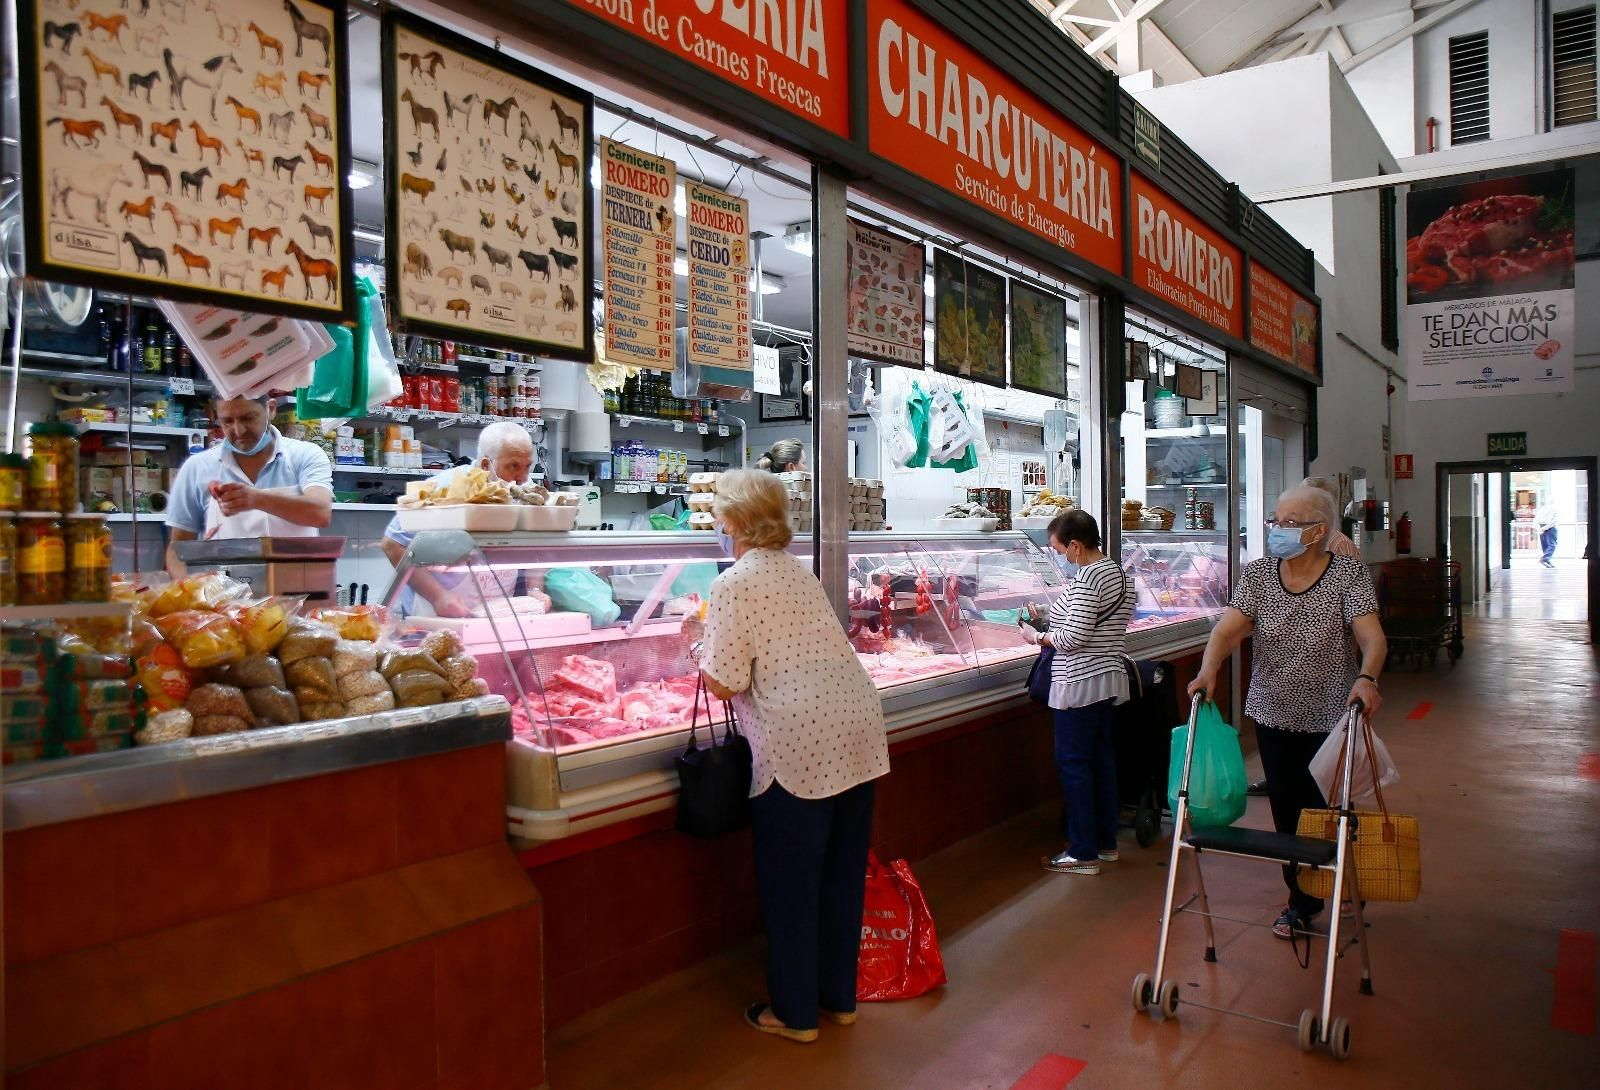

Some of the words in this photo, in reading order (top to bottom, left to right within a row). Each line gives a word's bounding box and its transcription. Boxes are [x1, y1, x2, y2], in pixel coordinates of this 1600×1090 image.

[643, 0, 669, 41] de
[677, 15, 749, 81] Carnes
[755, 54, 822, 118] Frescas
[878, 18, 1114, 240] CHARCUTERÍA
[607, 143, 666, 175] Carnicería
[606, 160, 670, 198] ROMERO
[605, 184, 643, 207] DESPIECE
[645, 197, 654, 210] de
[955, 163, 1007, 213] Servicio
[1011, 193, 1024, 222] de
[1028, 202, 1075, 249] Encargos
[605, 198, 653, 232] TERNERA
[690, 202, 744, 236] ROMERO
[690, 225, 721, 244] DESPIECE
[690, 239, 730, 266] CERDO
[1137, 193, 1234, 311] ROMERO
[1147, 268, 1188, 306] Elaboración
[1188, 291, 1208, 319] Propia
[1444, 302, 1486, 312] MERCADOS
[1422, 314, 1444, 332] TE
[1451, 310, 1499, 330] DAN
[1507, 300, 1558, 325] MÁS
[1429, 323, 1549, 349] SELECCIÓN
[1488, 436, 1526, 451] SALIDA
